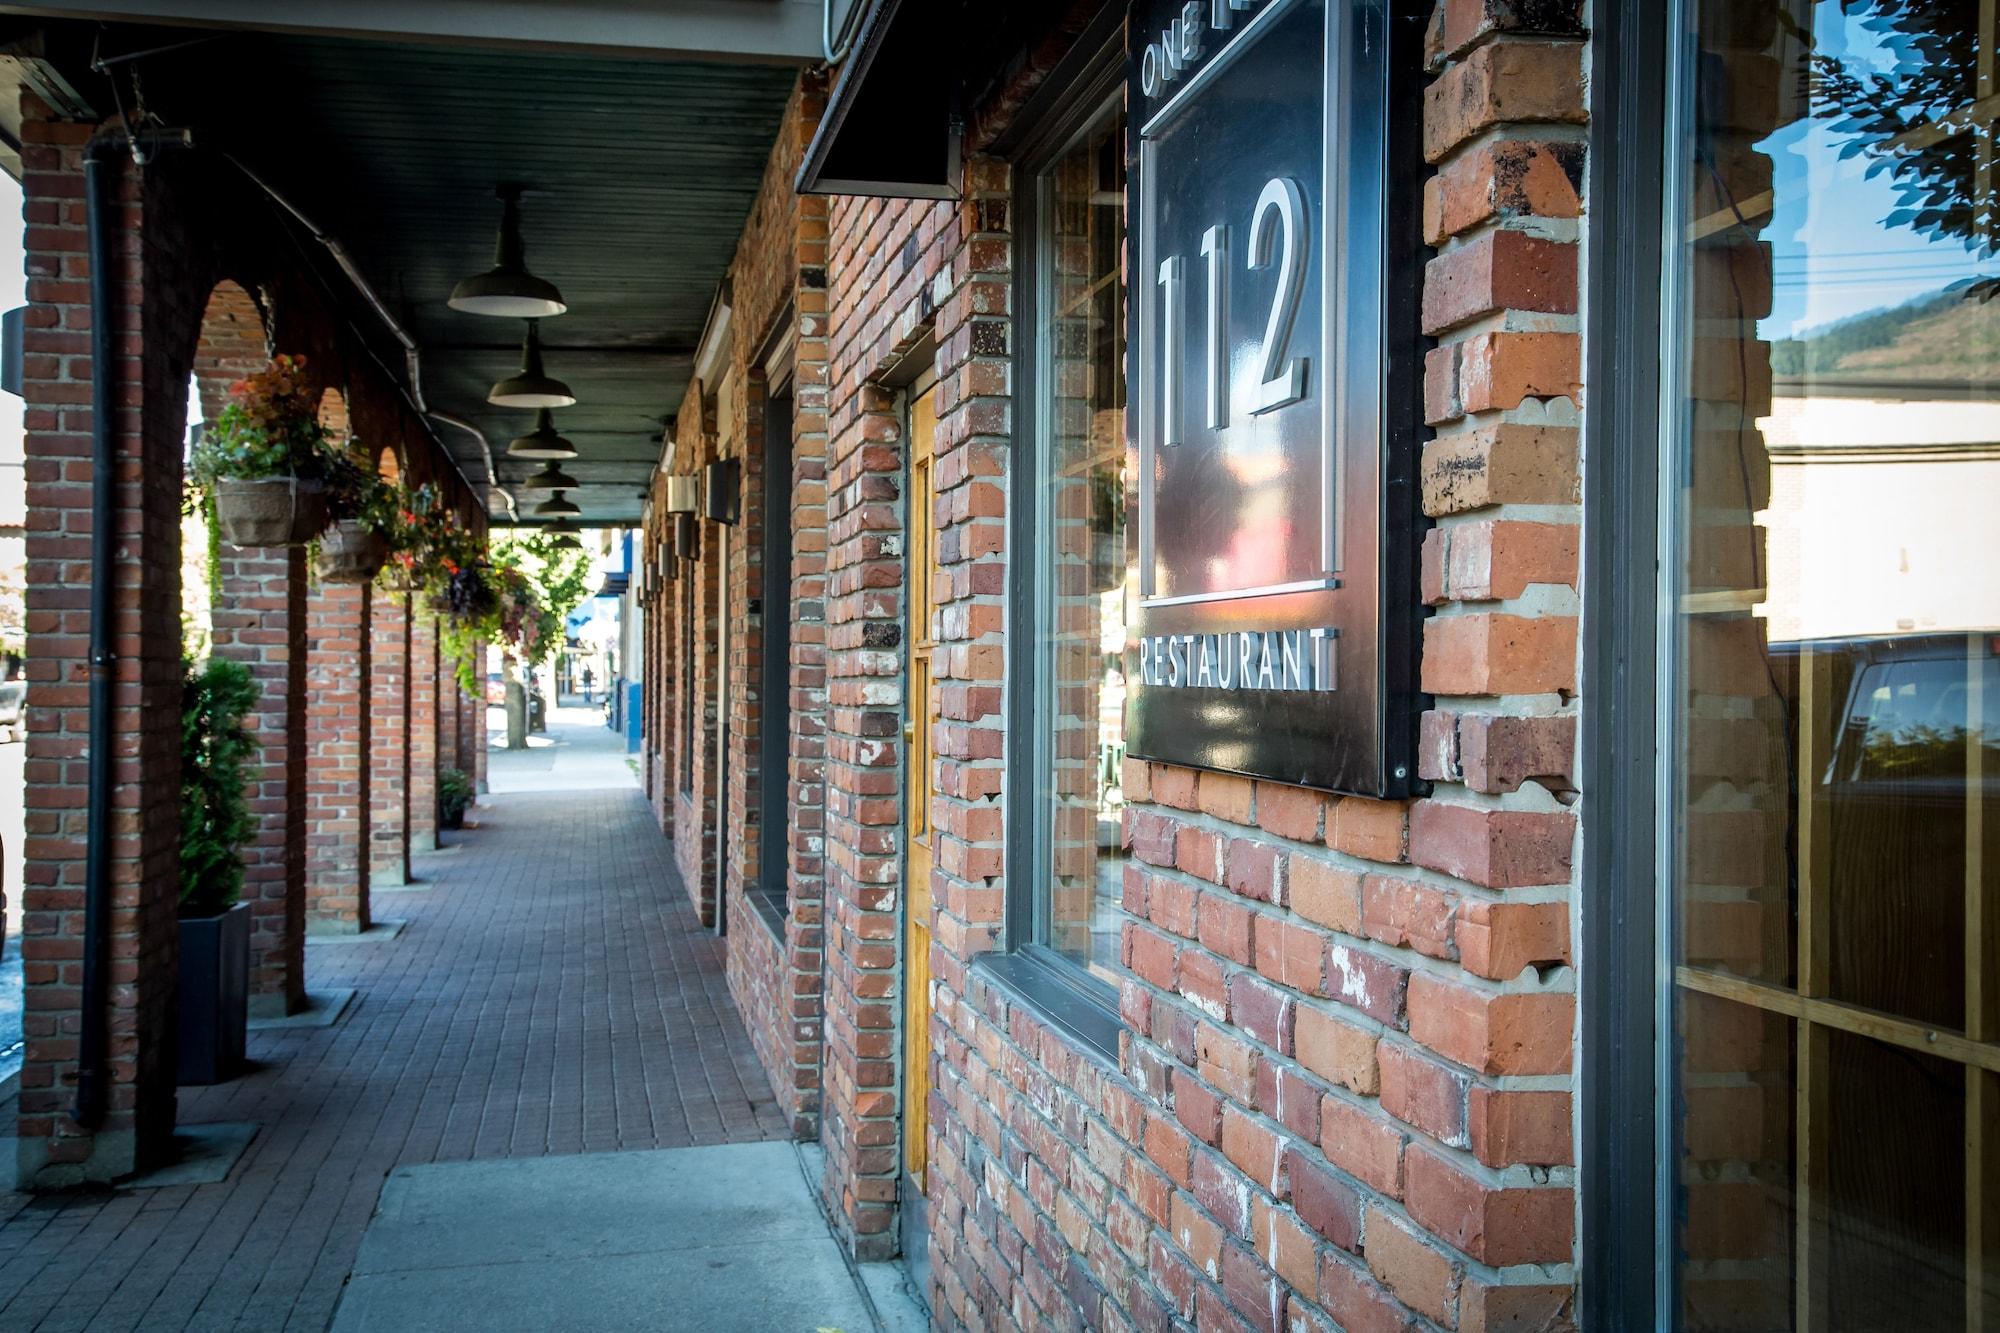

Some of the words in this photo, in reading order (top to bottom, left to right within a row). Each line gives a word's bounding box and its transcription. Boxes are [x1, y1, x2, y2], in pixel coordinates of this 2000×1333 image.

[1142, 1, 1198, 97] ONE
[1158, 177, 1308, 446] 112
[1140, 627, 1336, 691] RESTAURANT
